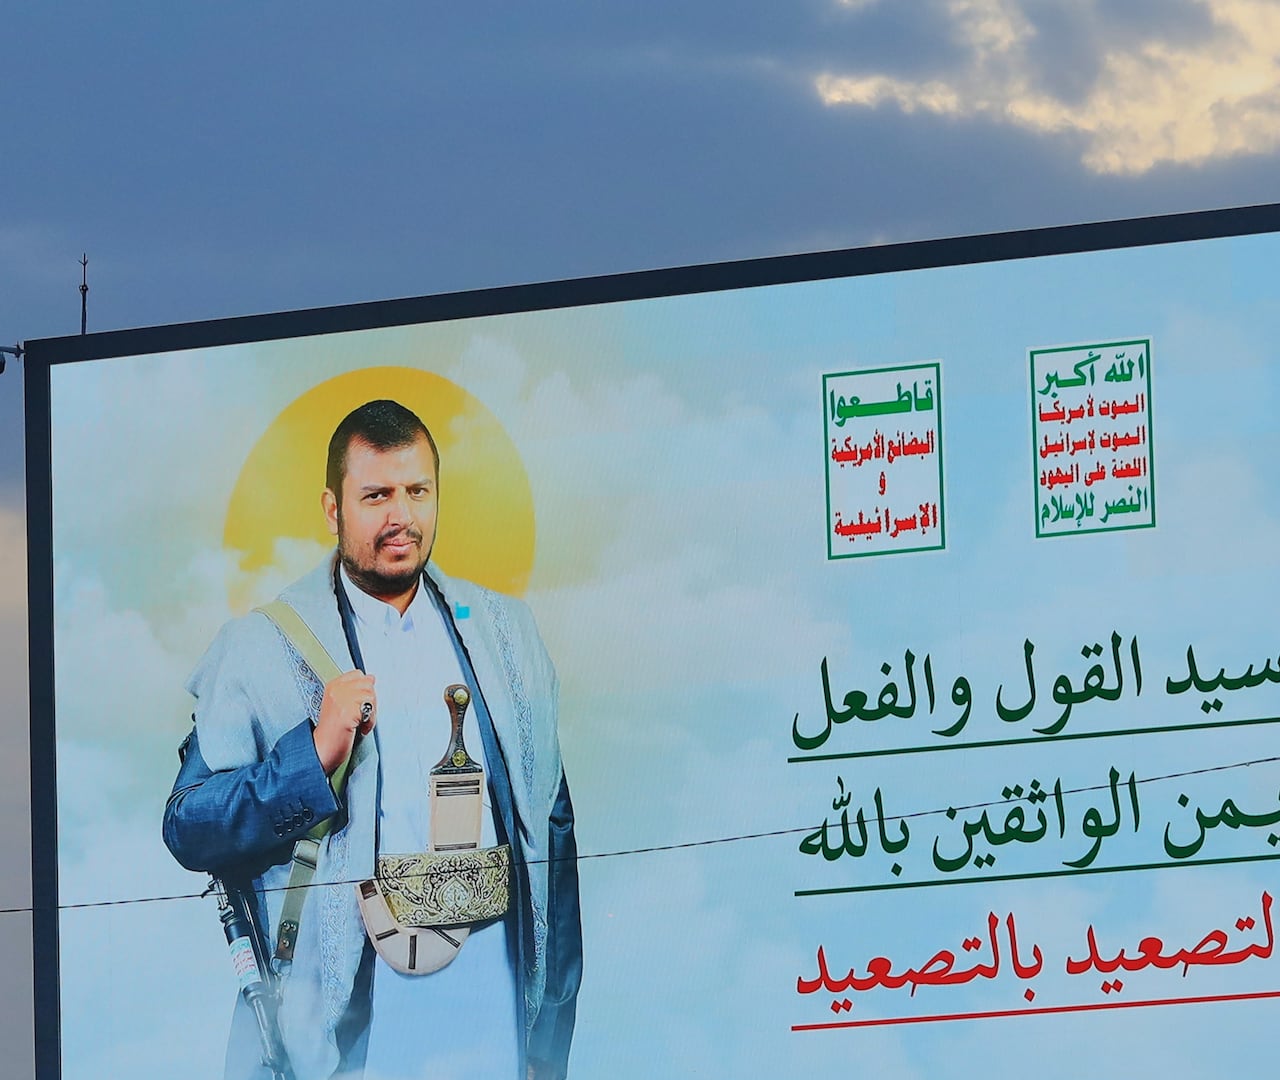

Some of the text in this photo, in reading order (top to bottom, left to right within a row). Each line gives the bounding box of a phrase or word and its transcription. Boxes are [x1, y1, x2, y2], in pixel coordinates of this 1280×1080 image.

[1037, 350, 1146, 398] الله أكبر
[830, 379, 934, 428] قاطعوا
[1038, 392, 1145, 425] الموت لأمريكا
[831, 428, 935, 468] البضائع الأمريكية
[1039, 424, 1146, 458] الموت لإسرائيل
[878, 471, 887, 496] و
[1039, 456, 1147, 490] اللعنة على اليهود
[833, 501, 938, 543] الإسرائيلية
[1041, 484, 1148, 529] النصر للإسلام
[792, 648, 973, 751] والفعل
[995, 630, 1144, 736] القول
[798, 776, 911, 878] بالله
[932, 764, 1142, 873] الواثقين
[796, 911, 1044, 1015] بالتصعيد
